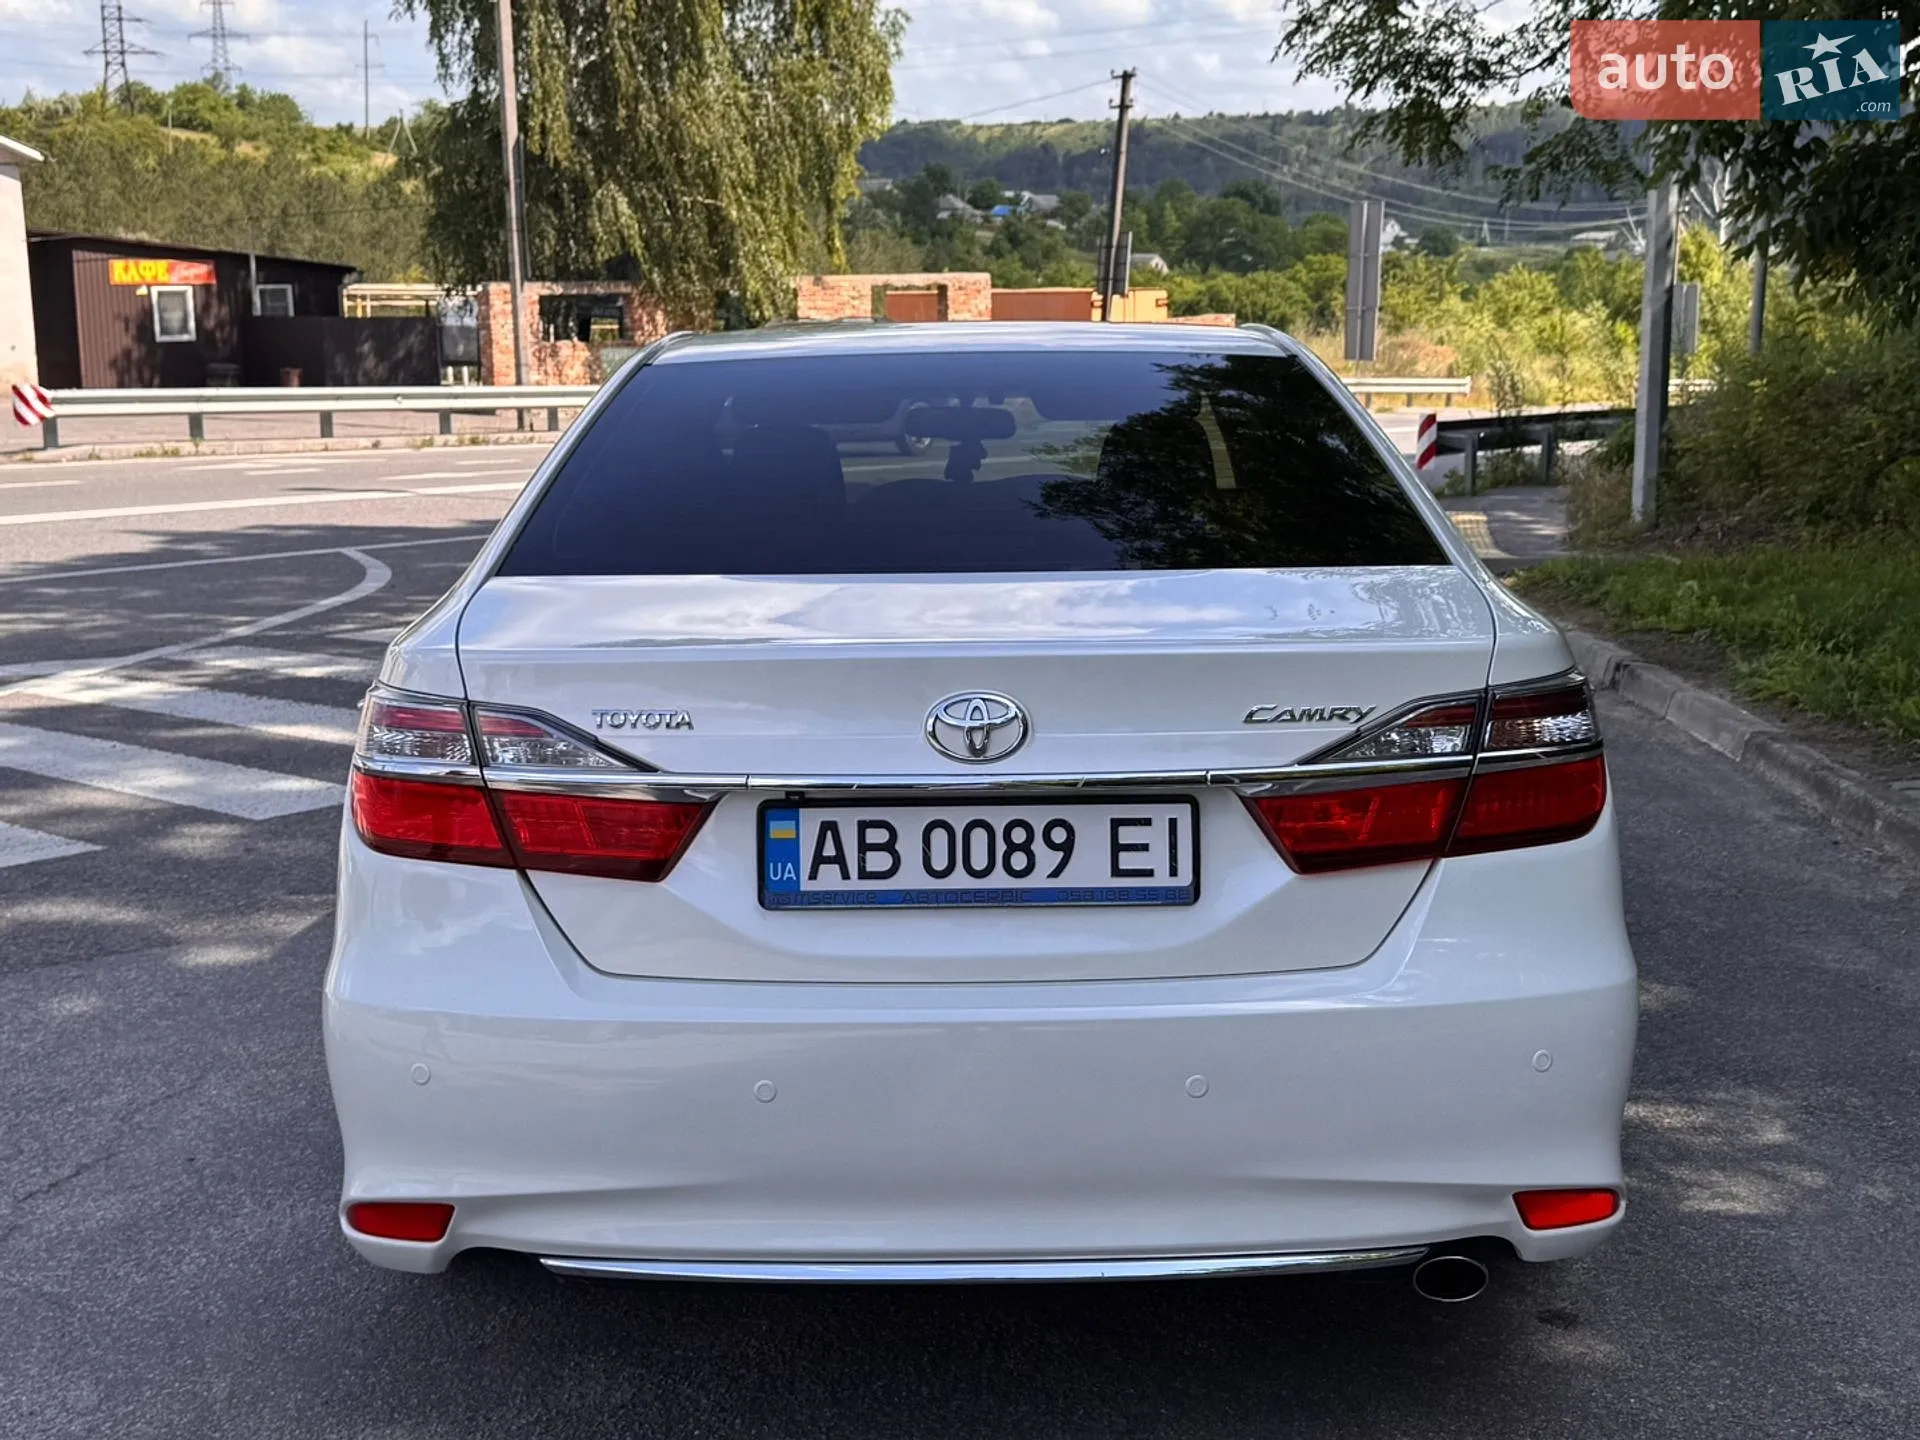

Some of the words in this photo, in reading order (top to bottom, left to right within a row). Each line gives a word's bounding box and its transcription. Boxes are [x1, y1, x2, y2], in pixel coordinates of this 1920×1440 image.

[591, 708, 695, 731] TOYOTA
[1242, 703, 1377, 724] CAMRY
[807, 819, 902, 881] AB
[921, 818, 1076, 880] 0089
[1109, 816, 1180, 878] EI
[769, 862, 797, 881] UA
